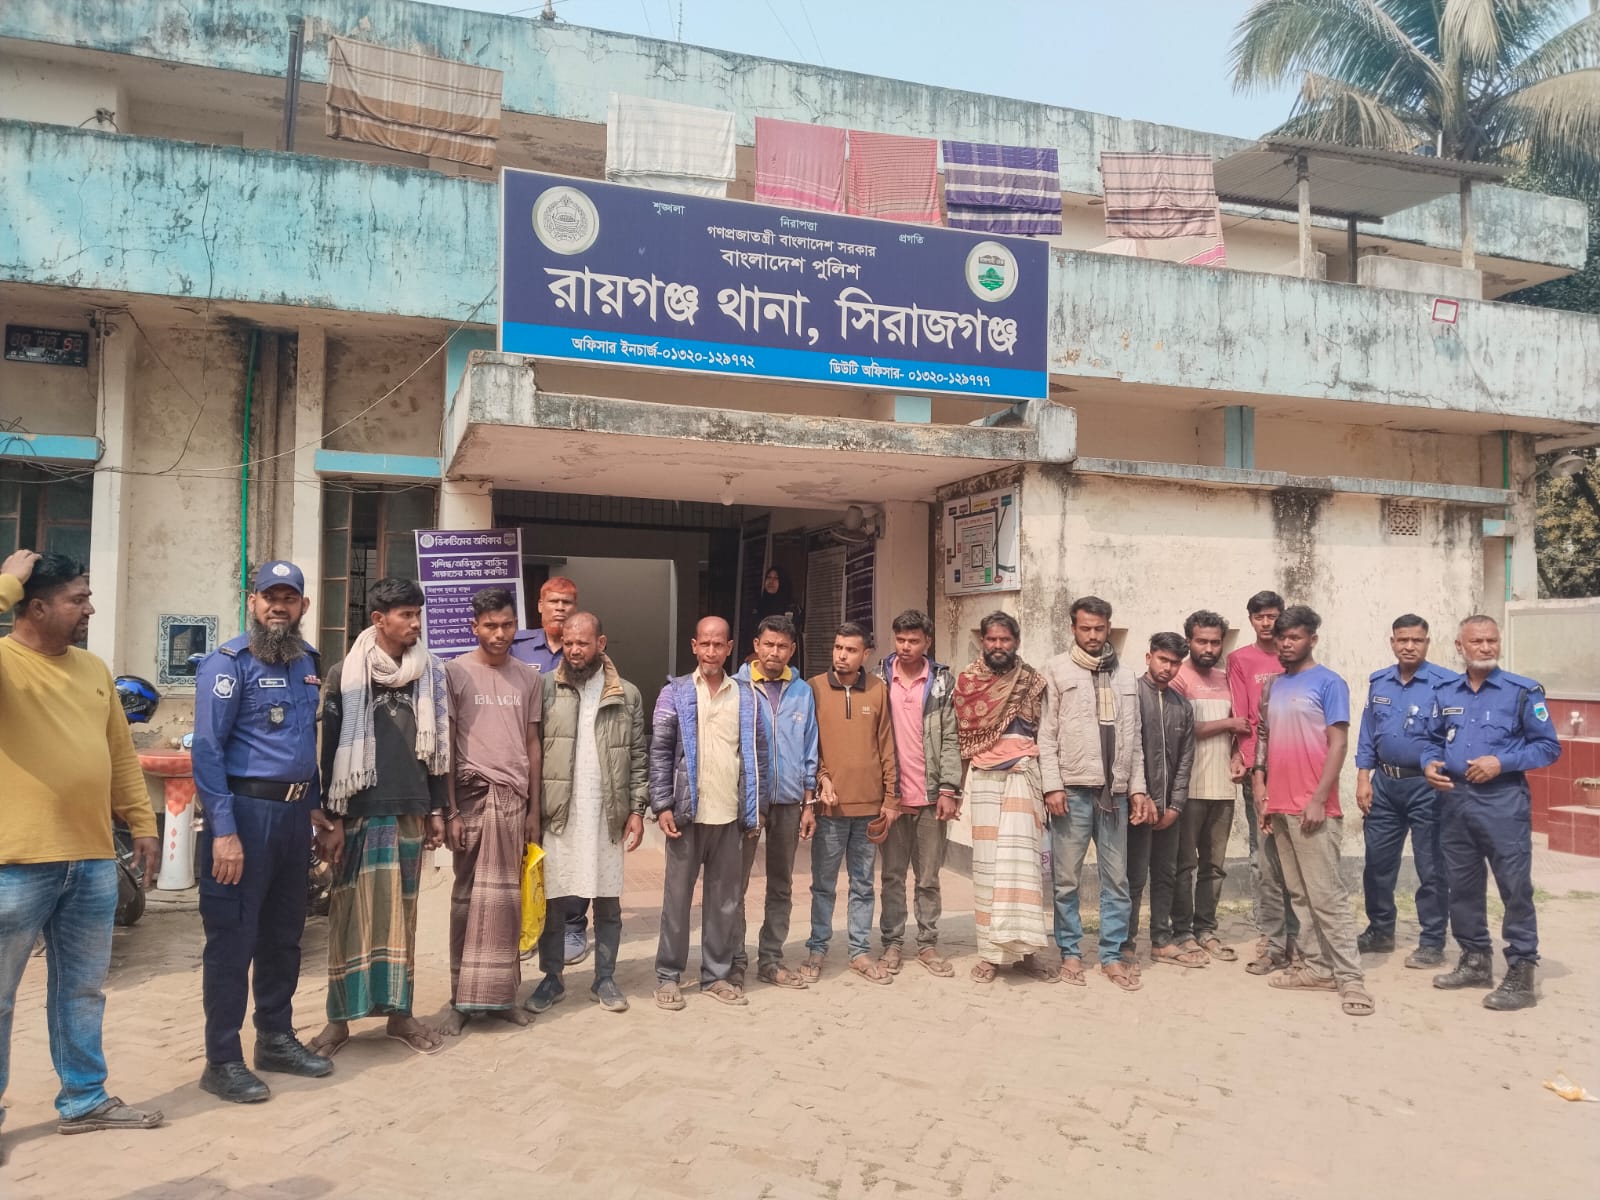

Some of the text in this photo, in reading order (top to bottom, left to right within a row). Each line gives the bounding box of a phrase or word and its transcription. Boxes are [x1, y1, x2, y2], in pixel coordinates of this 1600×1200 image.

[780, 215, 818, 232] নিরাপত্তা
[898, 233, 925, 245] প্রগতি
[780, 233, 834, 253] বাংলাদেশ
[837, 243, 877, 257] সরকার
[720, 248, 862, 281] বাংলাদেশ পুলিশ
[543, 265, 1019, 356] রায়গঞ্জ থানা, সিরাজগঞ্জ
[571, 335, 617, 355] অফিসার
[828, 358, 859, 376] ডিউটি
